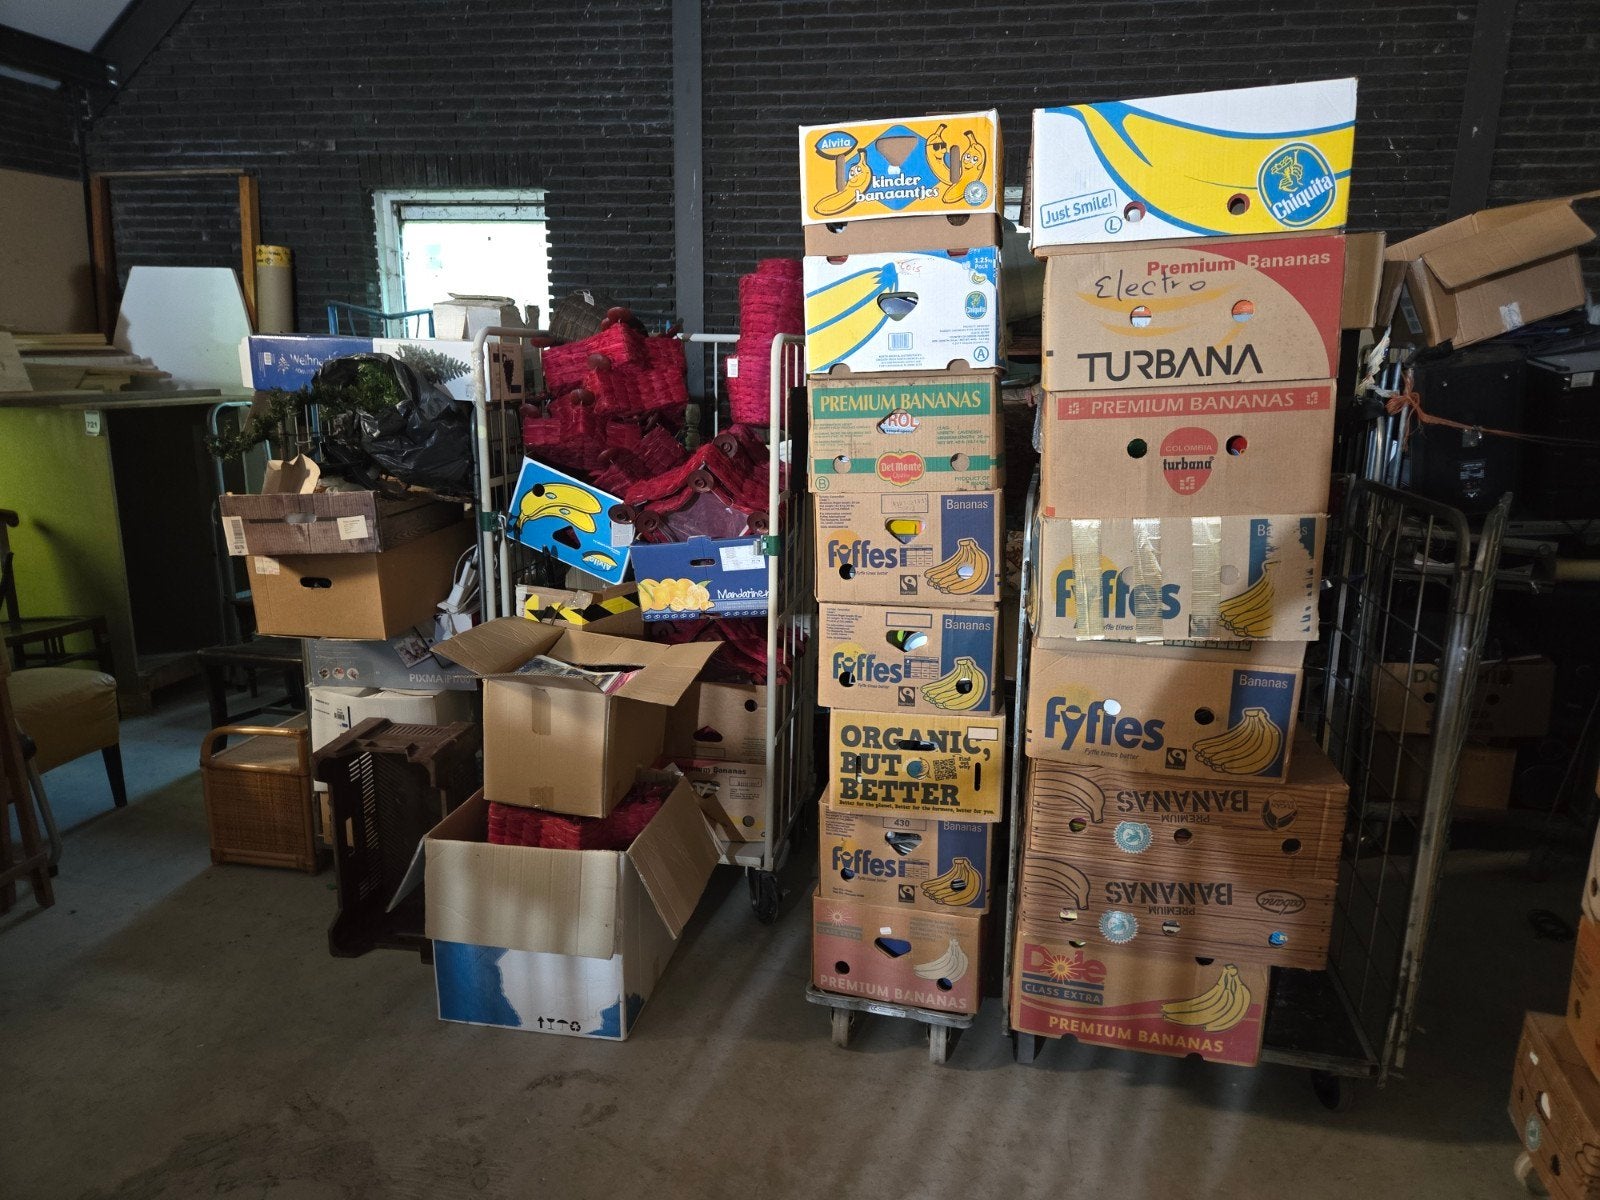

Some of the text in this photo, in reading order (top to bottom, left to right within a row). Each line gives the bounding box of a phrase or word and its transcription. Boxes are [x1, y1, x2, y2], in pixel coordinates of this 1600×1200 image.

[821, 137, 851, 149] Alvita
[871, 173, 921, 188] kinder
[855, 184, 939, 202] banaantjes
[1271, 174, 1334, 221] Chiquita
[1045, 204, 1071, 224] Just
[1147, 252, 1331, 276] Premium Bananas
[1095, 269, 1206, 301] Electro
[1077, 344, 1264, 382] TURBANA
[820, 390, 981, 412] PREMIUM BANANAS
[1091, 392, 1294, 415] PREMIUM BANANAS
[1165, 444, 1212, 452] COLOMBIA
[881, 462, 922, 471] Del Monte
[1163, 457, 1212, 471] turbana
[818, 478, 826, 488] B
[946, 499, 988, 510] Bananas
[945, 618, 991, 631] Bananas
[409, 673, 443, 684] PIXMA
[1239, 674, 1289, 690] Bananas
[1045, 696, 1165, 751] fyffes
[840, 724, 991, 761] ORGANIC,
[840, 751, 902, 777] BUT
[840, 777, 960, 806] BETTER
[1116, 790, 1249, 812] BANANAS
[894, 818, 910, 827] 430
[943, 821, 982, 833] Bananas
[1161, 814, 1210, 823] PREMIUM
[1105, 882, 1233, 905] BANANAS
[1149, 905, 1196, 916] PREMIUM
[820, 974, 968, 1010] PREMIUM BANANAS
[1025, 983, 1100, 1003] CLASS EXTRA
[1049, 1015, 1225, 1052] PREMIUM BANANAS
